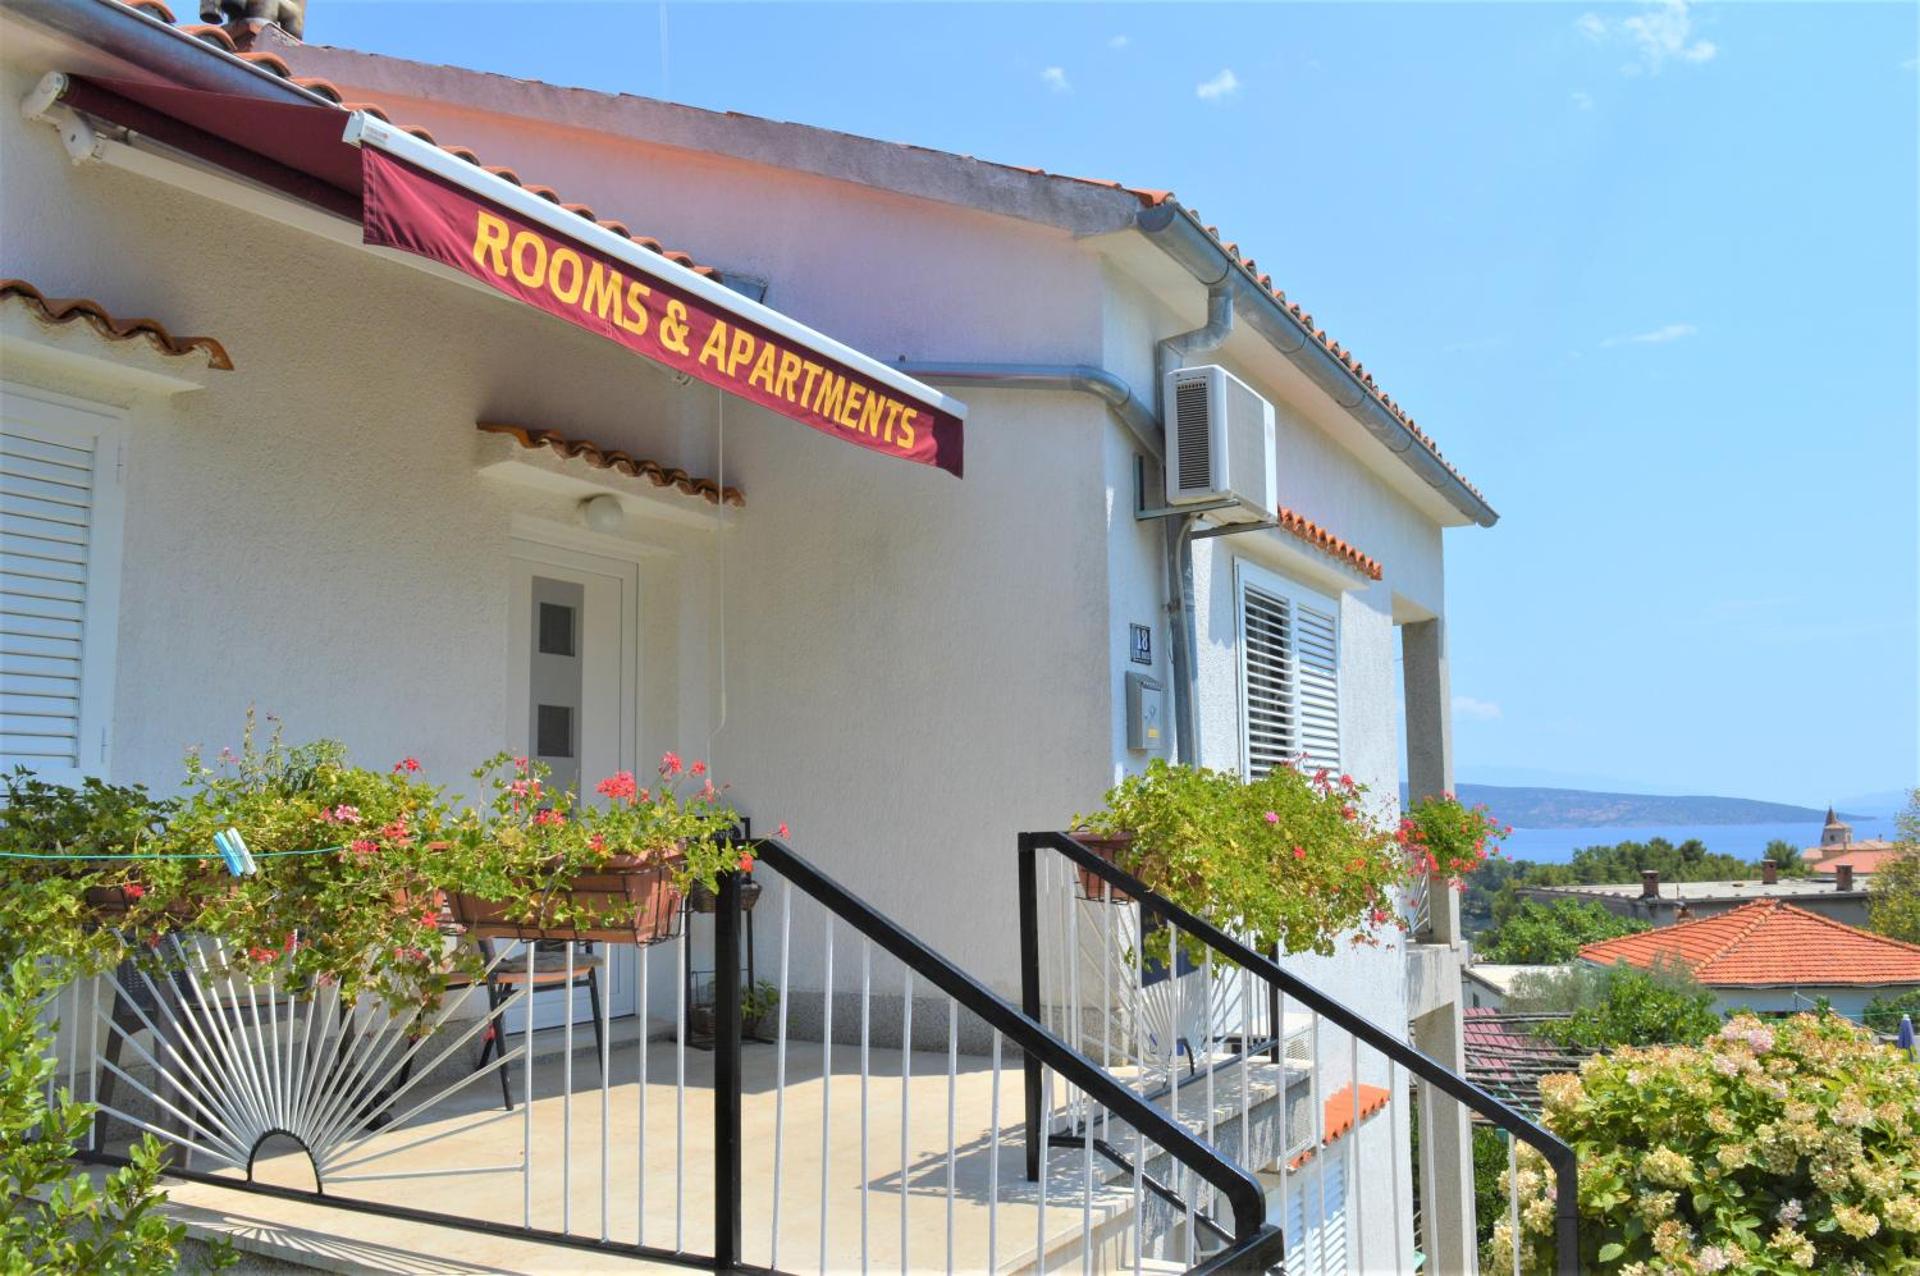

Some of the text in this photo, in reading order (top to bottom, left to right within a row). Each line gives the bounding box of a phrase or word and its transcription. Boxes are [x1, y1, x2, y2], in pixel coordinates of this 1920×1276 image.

[473, 211, 918, 449] ROOMS & APARTMENTS
[1137, 628, 1148, 650] 18
